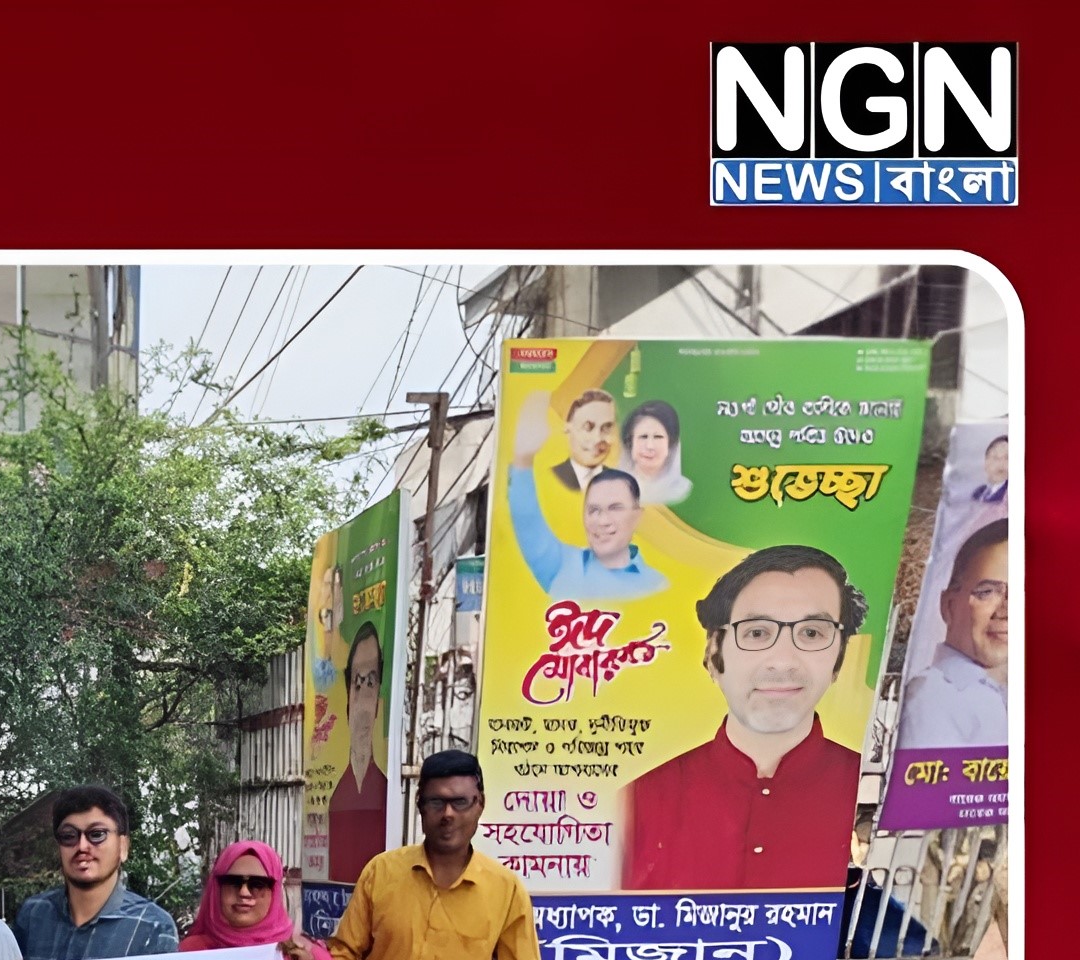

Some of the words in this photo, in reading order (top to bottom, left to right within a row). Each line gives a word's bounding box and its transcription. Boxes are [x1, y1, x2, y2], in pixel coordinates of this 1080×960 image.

[730, 463, 893, 511] শুভেচ্ছা
[545, 600, 621, 653] ঈদ
[504, 790, 566, 813] দোয়া
[577, 790, 599, 810] ও
[479, 814, 613, 846] সহযোগিতা
[497, 855, 592, 879] কামনায়
[674, 897, 759, 933] মিজানুর
[764, 901, 838, 929] রহমান
